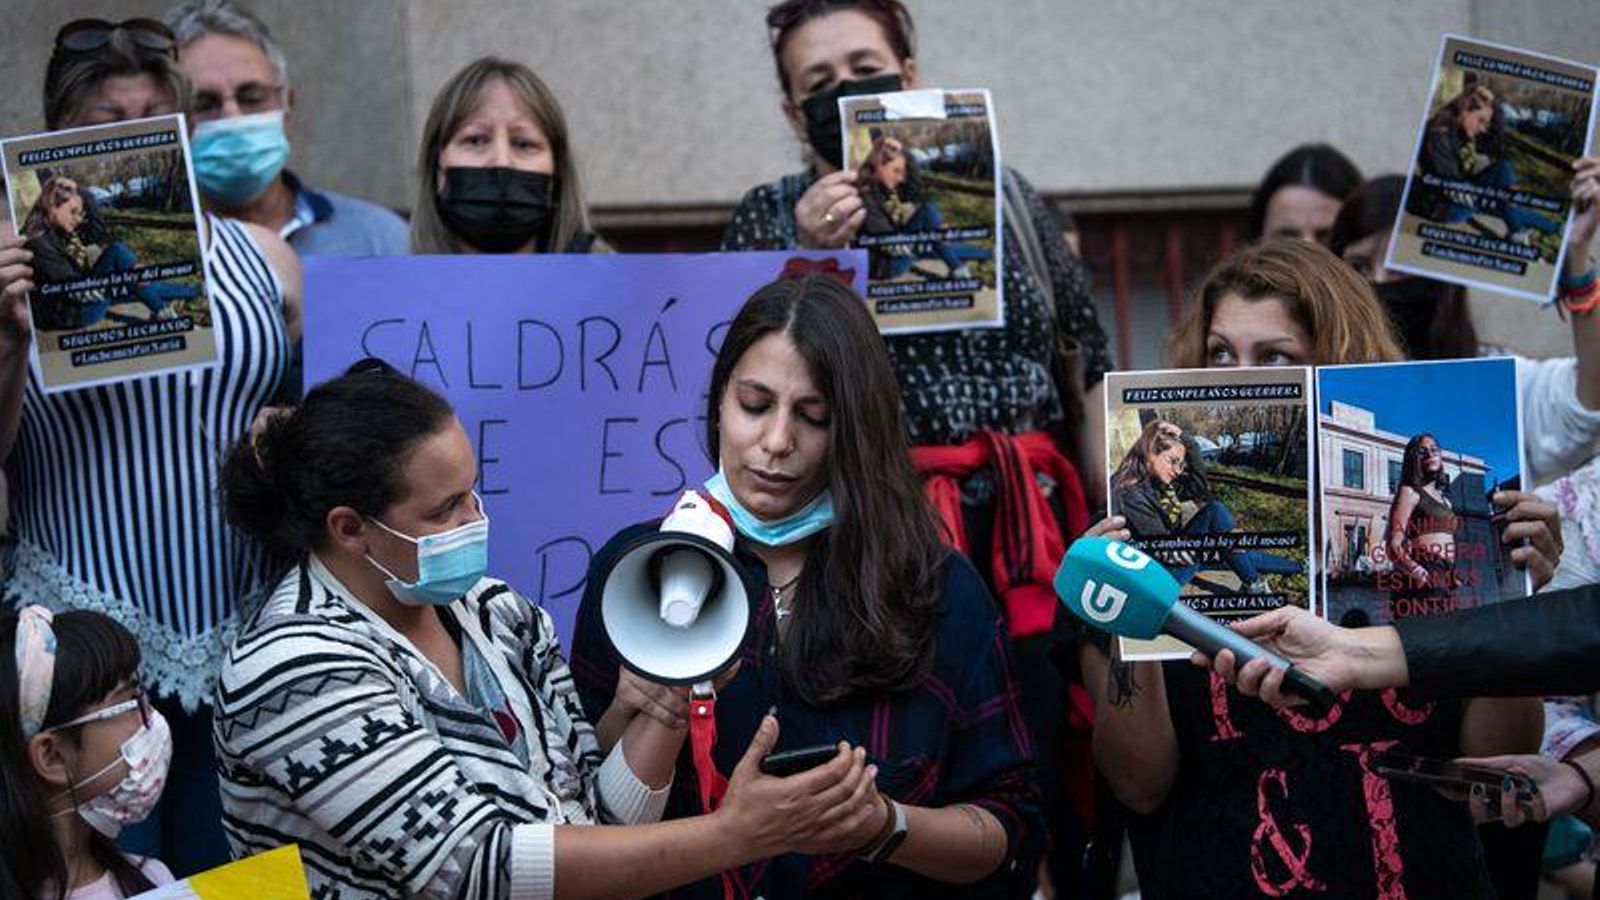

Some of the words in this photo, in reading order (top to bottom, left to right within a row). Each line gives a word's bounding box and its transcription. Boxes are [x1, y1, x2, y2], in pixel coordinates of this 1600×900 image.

[1126, 389, 1157, 401] FELIZ
[1239, 385, 1300, 398] GUERRERA
[480, 418, 509, 494] E
[1203, 536, 1215, 548] la
[1238, 535, 1258, 547] del
[1081, 579, 1129, 623] G
[1213, 596, 1285, 609] LUCHANDO
